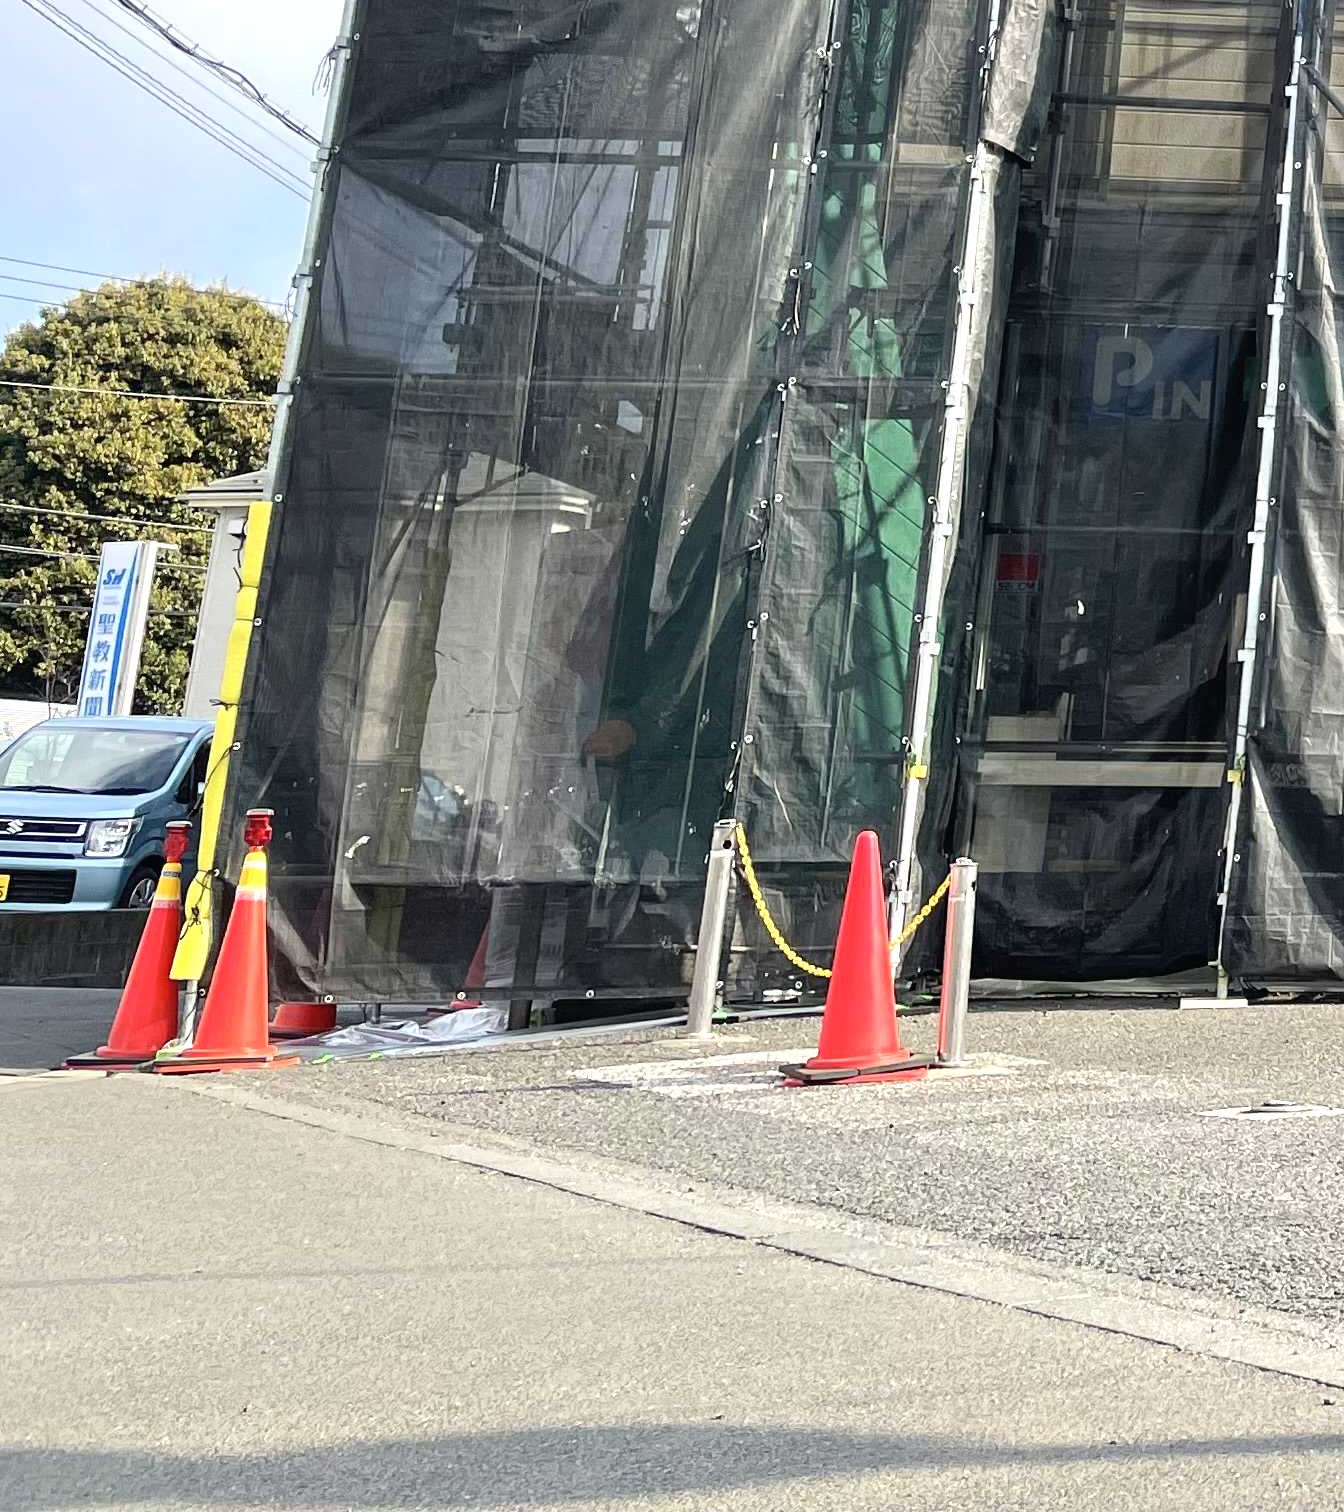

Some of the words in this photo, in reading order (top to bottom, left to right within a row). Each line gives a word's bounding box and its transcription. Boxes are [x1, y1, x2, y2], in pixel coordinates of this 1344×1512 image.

[1152, 380, 1212, 420] IN
[84, 613, 116, 716] 聖教新聞
